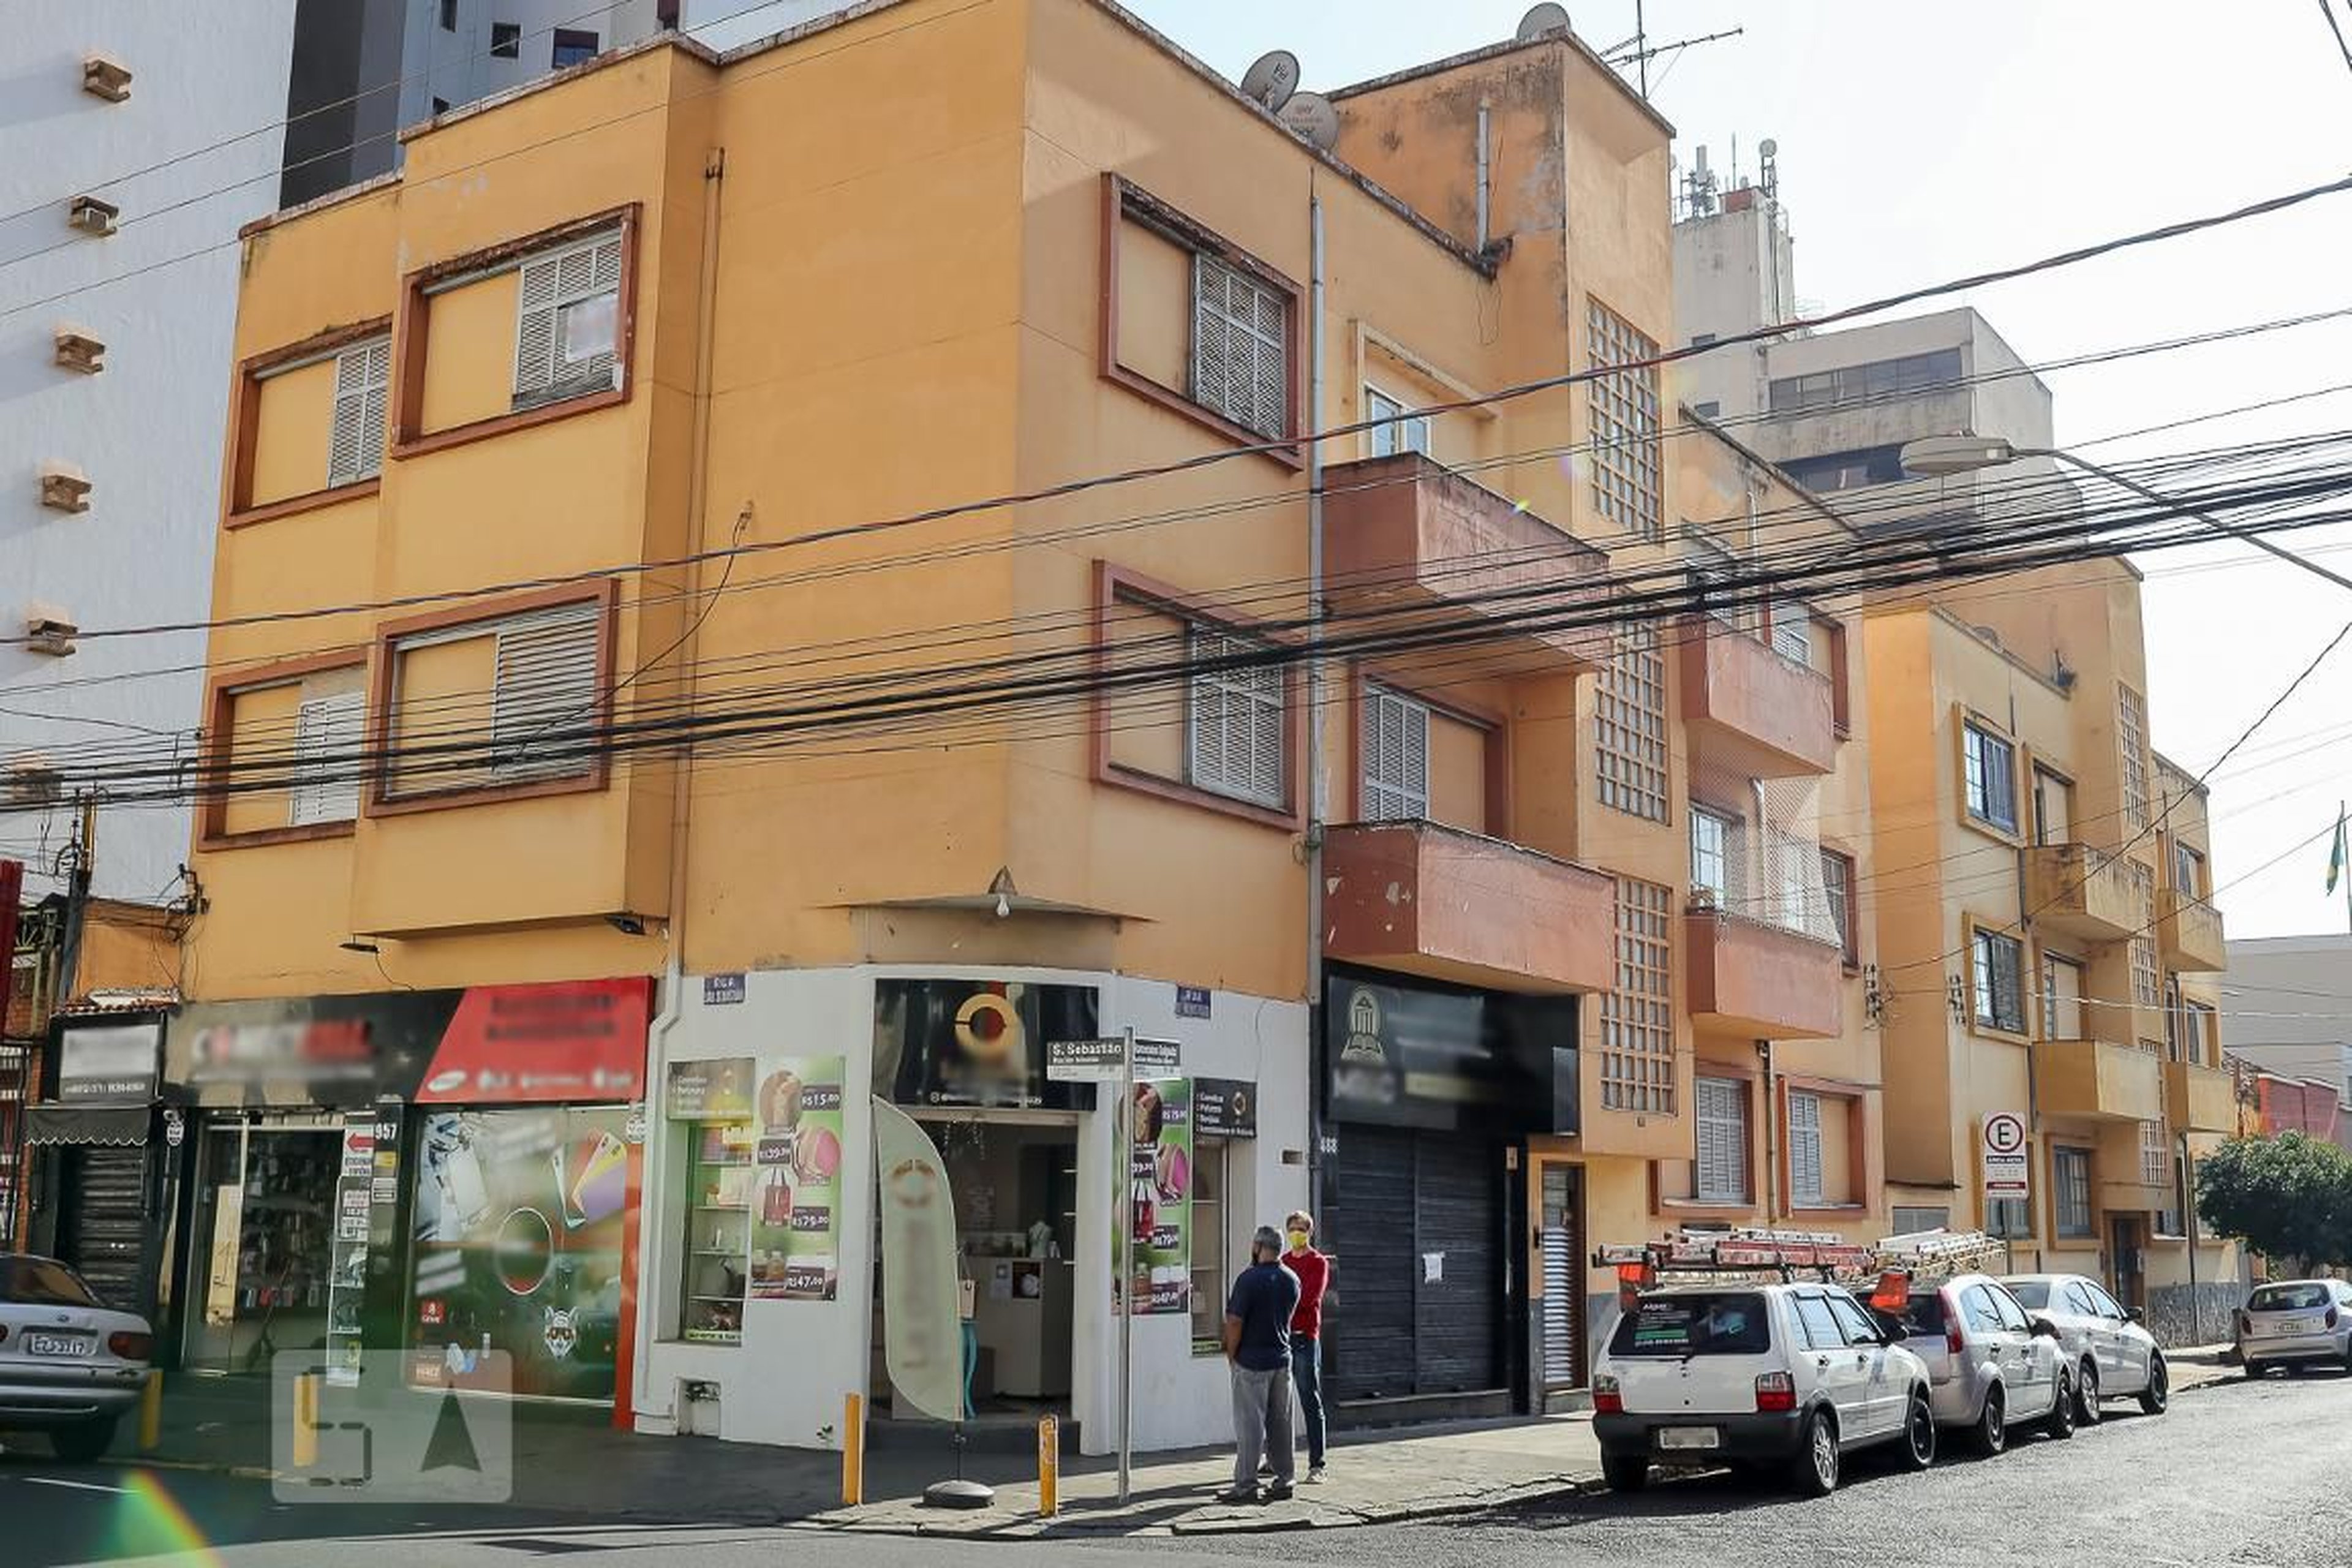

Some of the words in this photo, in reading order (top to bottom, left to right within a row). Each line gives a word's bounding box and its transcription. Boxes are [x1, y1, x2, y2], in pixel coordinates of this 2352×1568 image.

[1053, 1043, 1065, 1055] S.
[375, 1123, 397, 1140] 957
[1998, 1123, 2011, 1145] E
